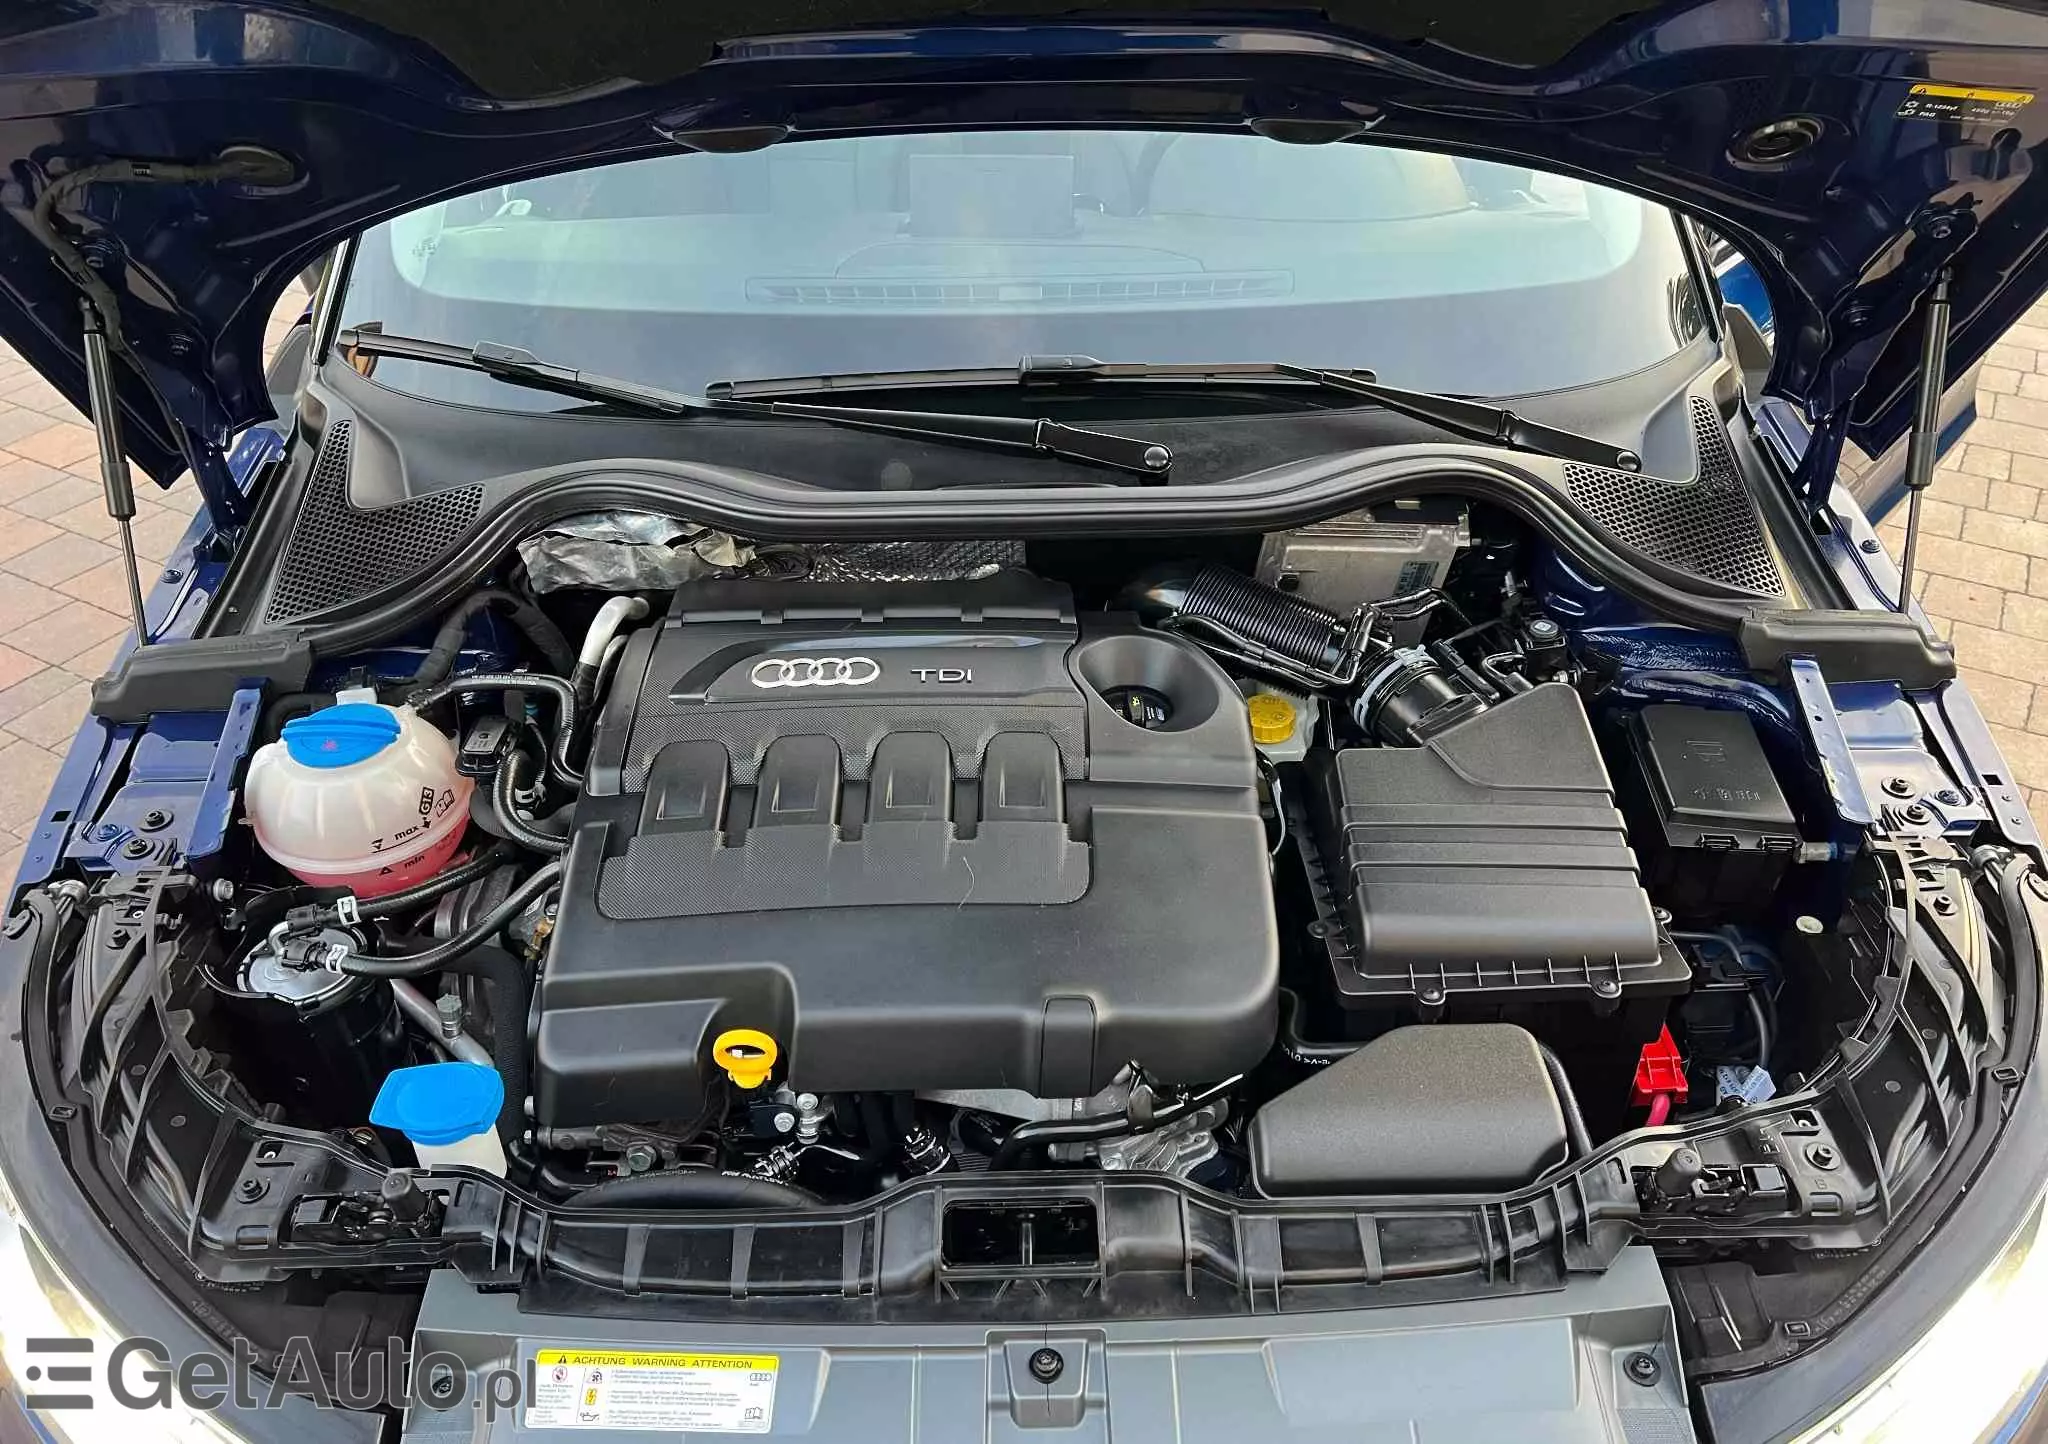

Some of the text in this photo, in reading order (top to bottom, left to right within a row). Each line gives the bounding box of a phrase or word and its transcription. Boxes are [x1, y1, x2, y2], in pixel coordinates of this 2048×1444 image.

[911, 668, 972, 683] TDI
[394, 825, 419, 840] max
[404, 855, 425, 868] min
[573, 1355, 753, 1369] ACHTUNG WARNING ATTENTION
